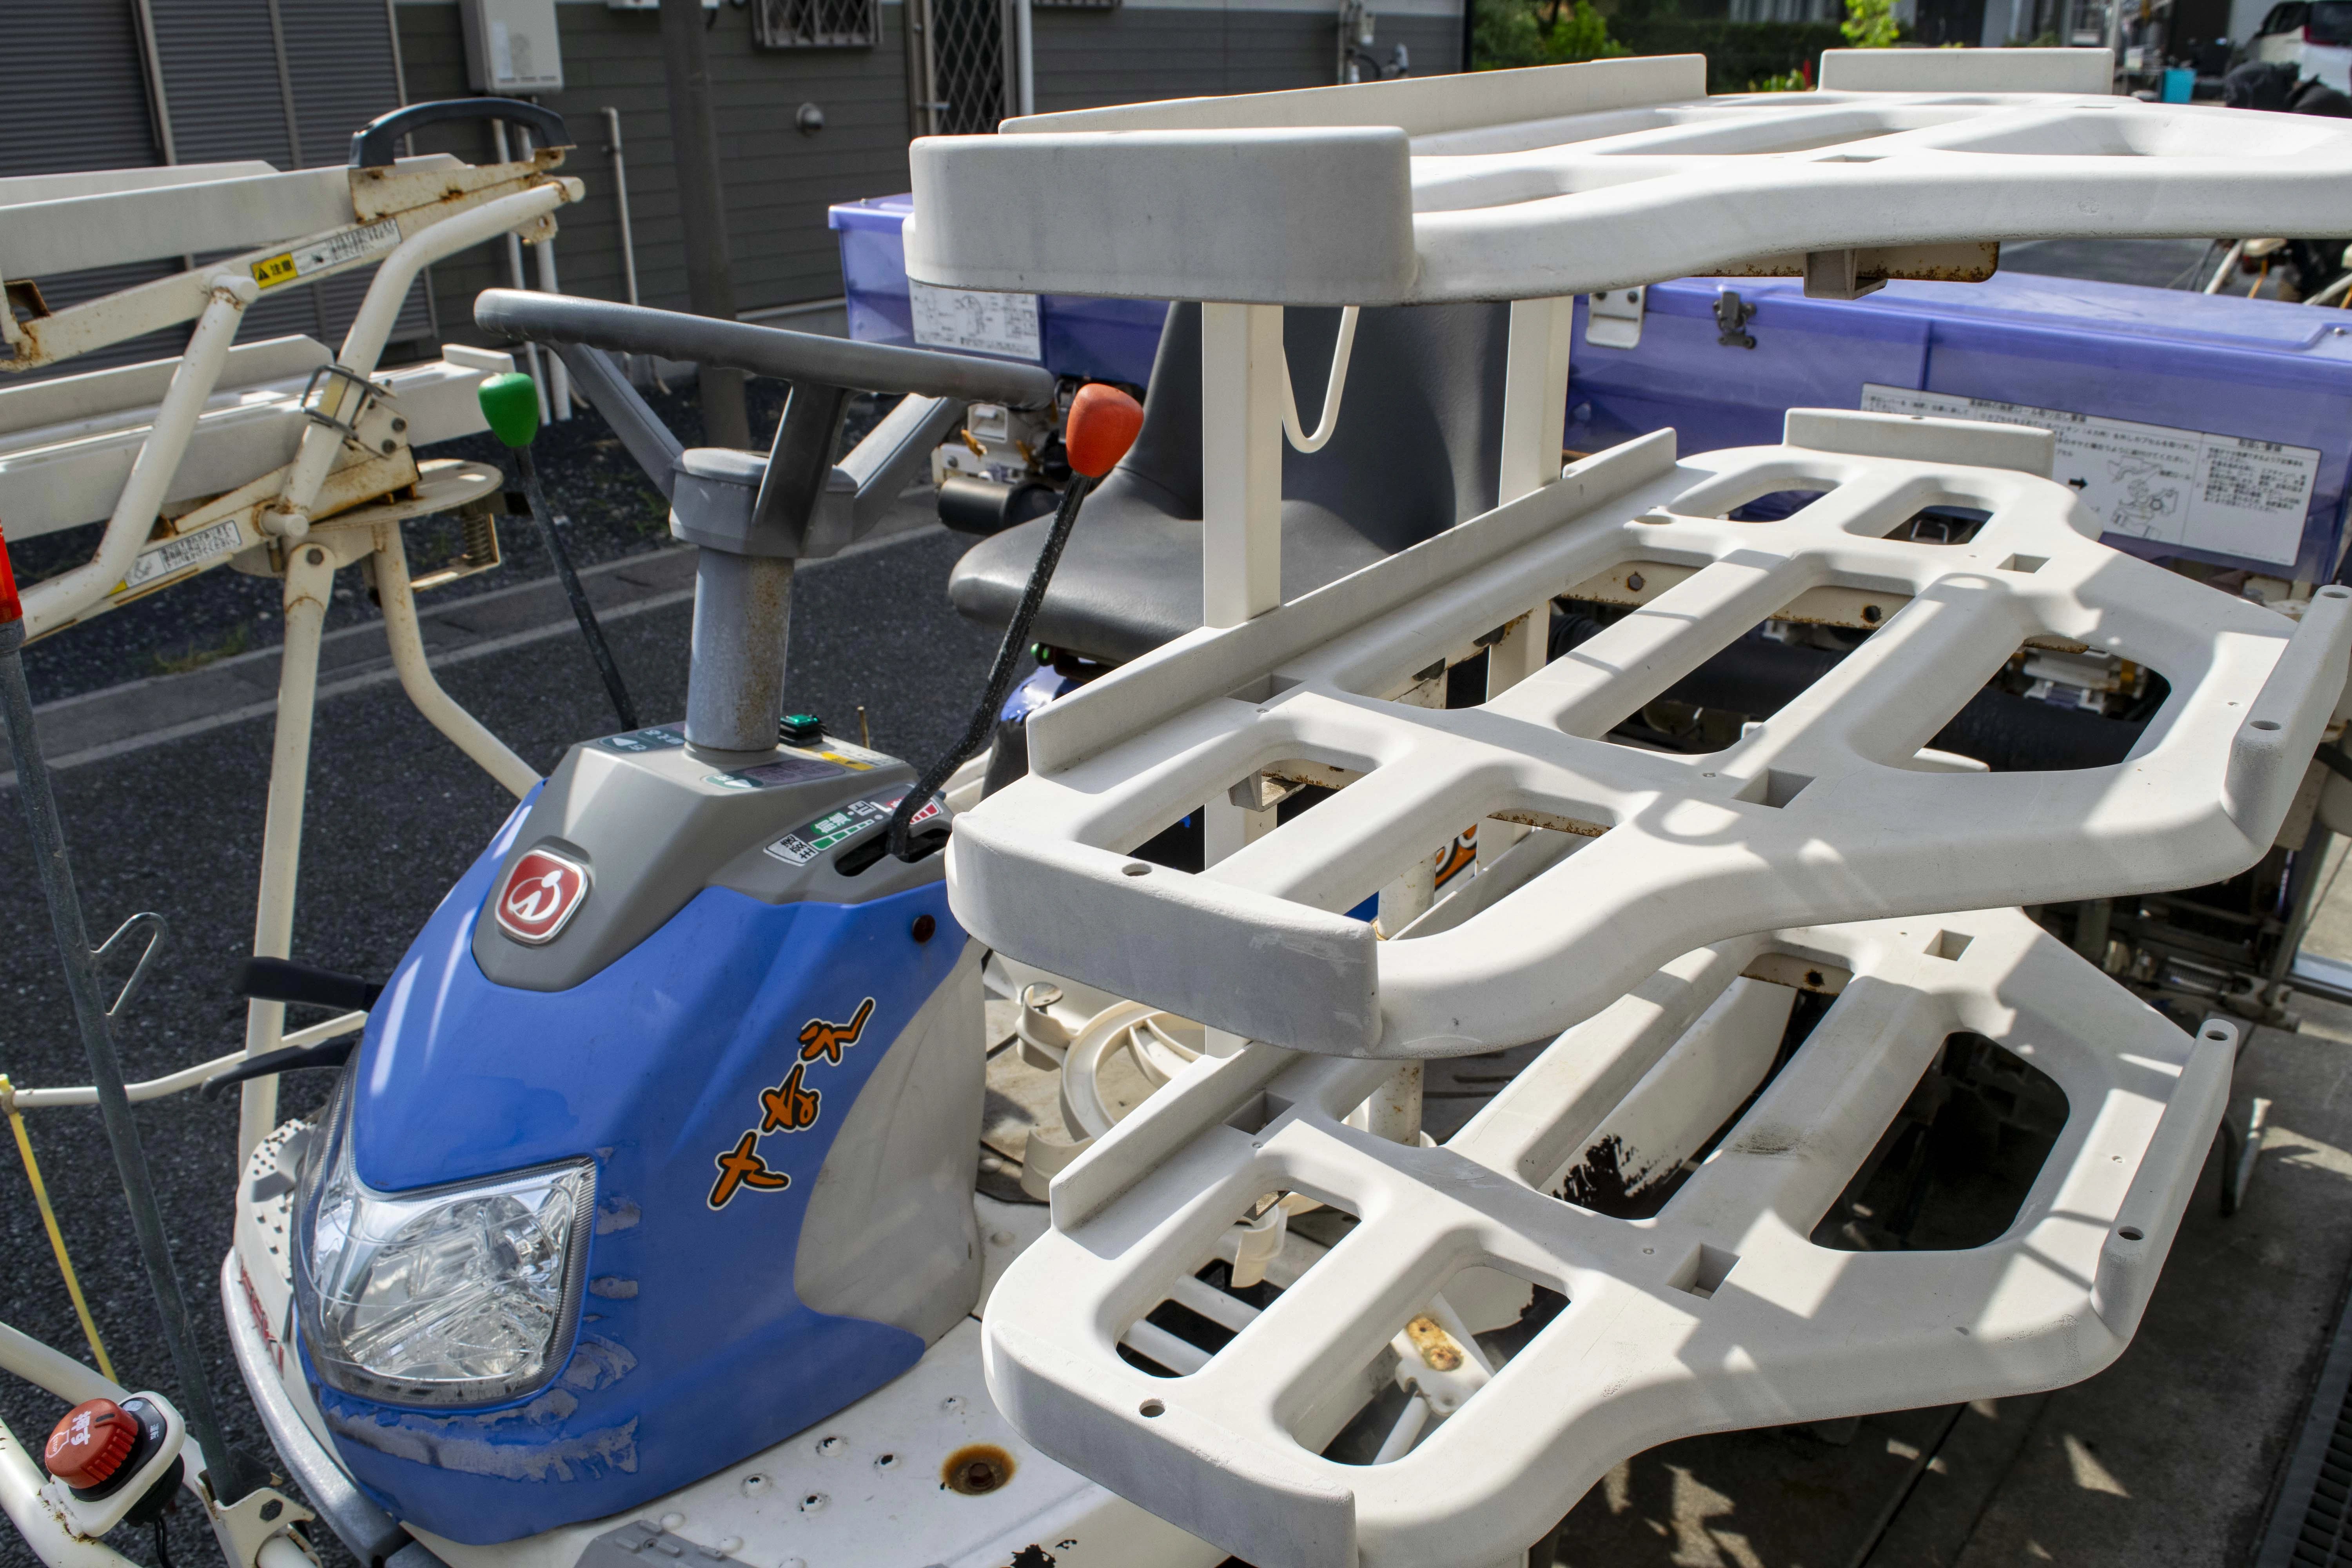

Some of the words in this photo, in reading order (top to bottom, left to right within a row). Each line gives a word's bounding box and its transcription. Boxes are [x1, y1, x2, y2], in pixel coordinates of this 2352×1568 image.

[270, 259, 293, 275] 注意
[780, 836, 816, 860] 主変速
[71, 1411, 91, 1446] 押す
